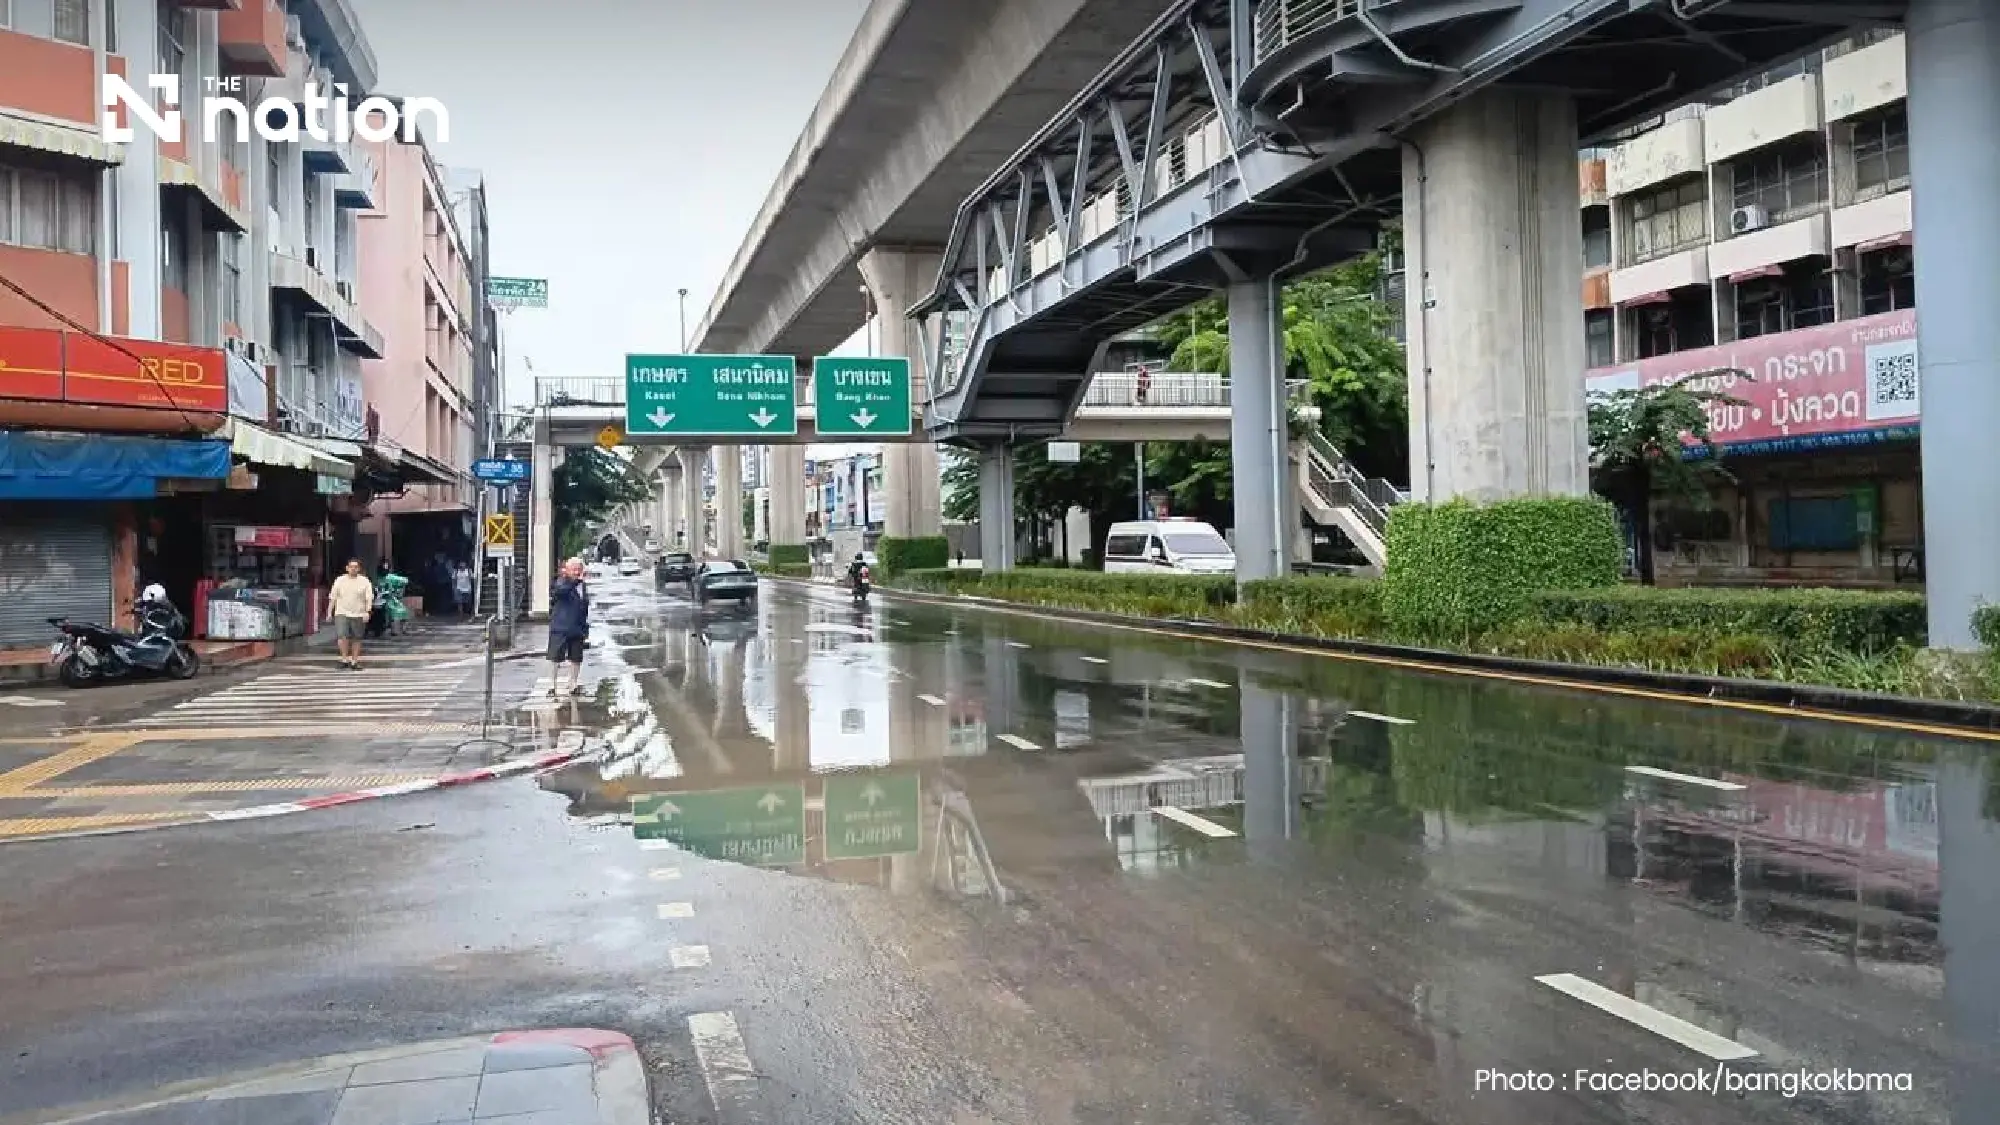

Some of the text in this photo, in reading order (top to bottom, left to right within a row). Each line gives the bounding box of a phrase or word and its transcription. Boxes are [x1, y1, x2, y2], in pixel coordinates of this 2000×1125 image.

[140, 358, 204, 383] RED
[632, 365, 689, 384] เกษตร
[713, 362, 789, 385] เสนานิคม
[1765, 345, 1847, 383] กระจก
[834, 368, 892, 386] บางเขน
[1771, 388, 1860, 435] มุ้งลวด
